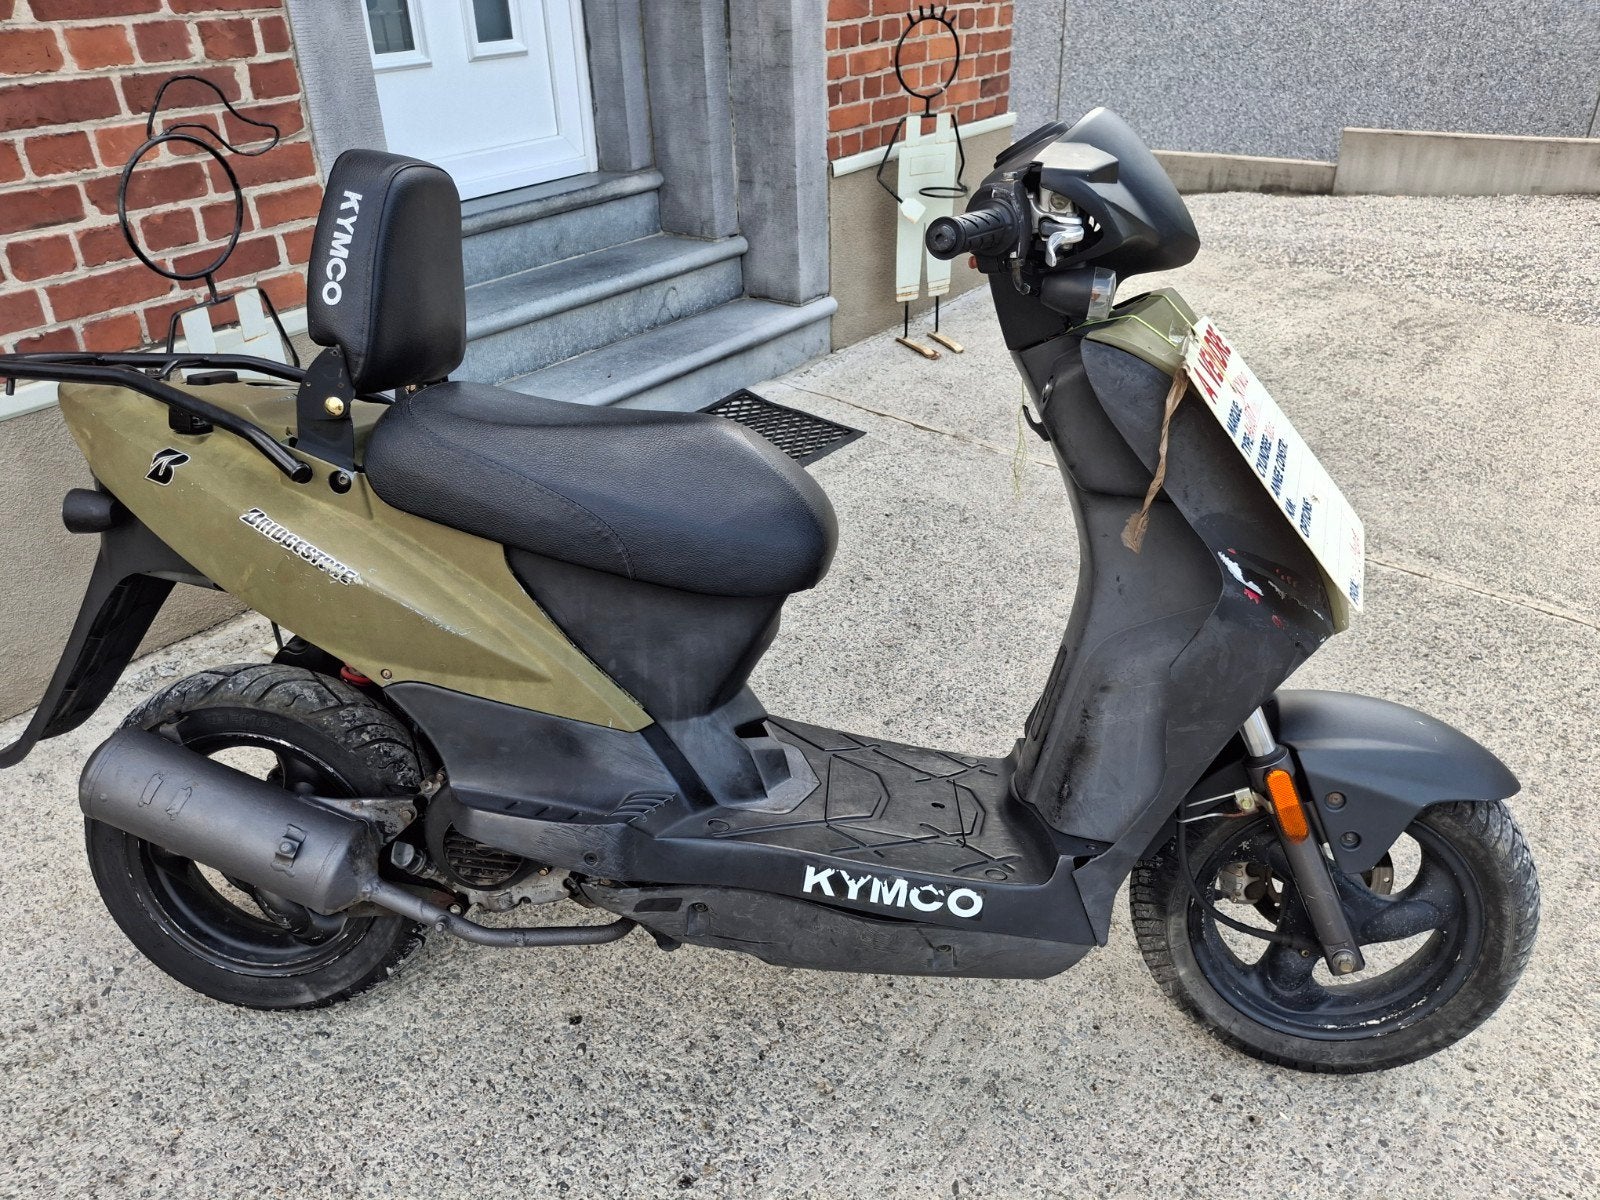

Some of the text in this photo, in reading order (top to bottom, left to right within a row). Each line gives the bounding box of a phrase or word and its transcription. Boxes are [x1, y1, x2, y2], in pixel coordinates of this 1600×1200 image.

[322, 190, 363, 306] KYMCO
[1193, 323, 1231, 404] A VENDRE
[1227, 399, 1242, 437] MARQUE:
[239, 508, 359, 587] BRIDGESTONE
[802, 864, 983, 918] KYMCO
